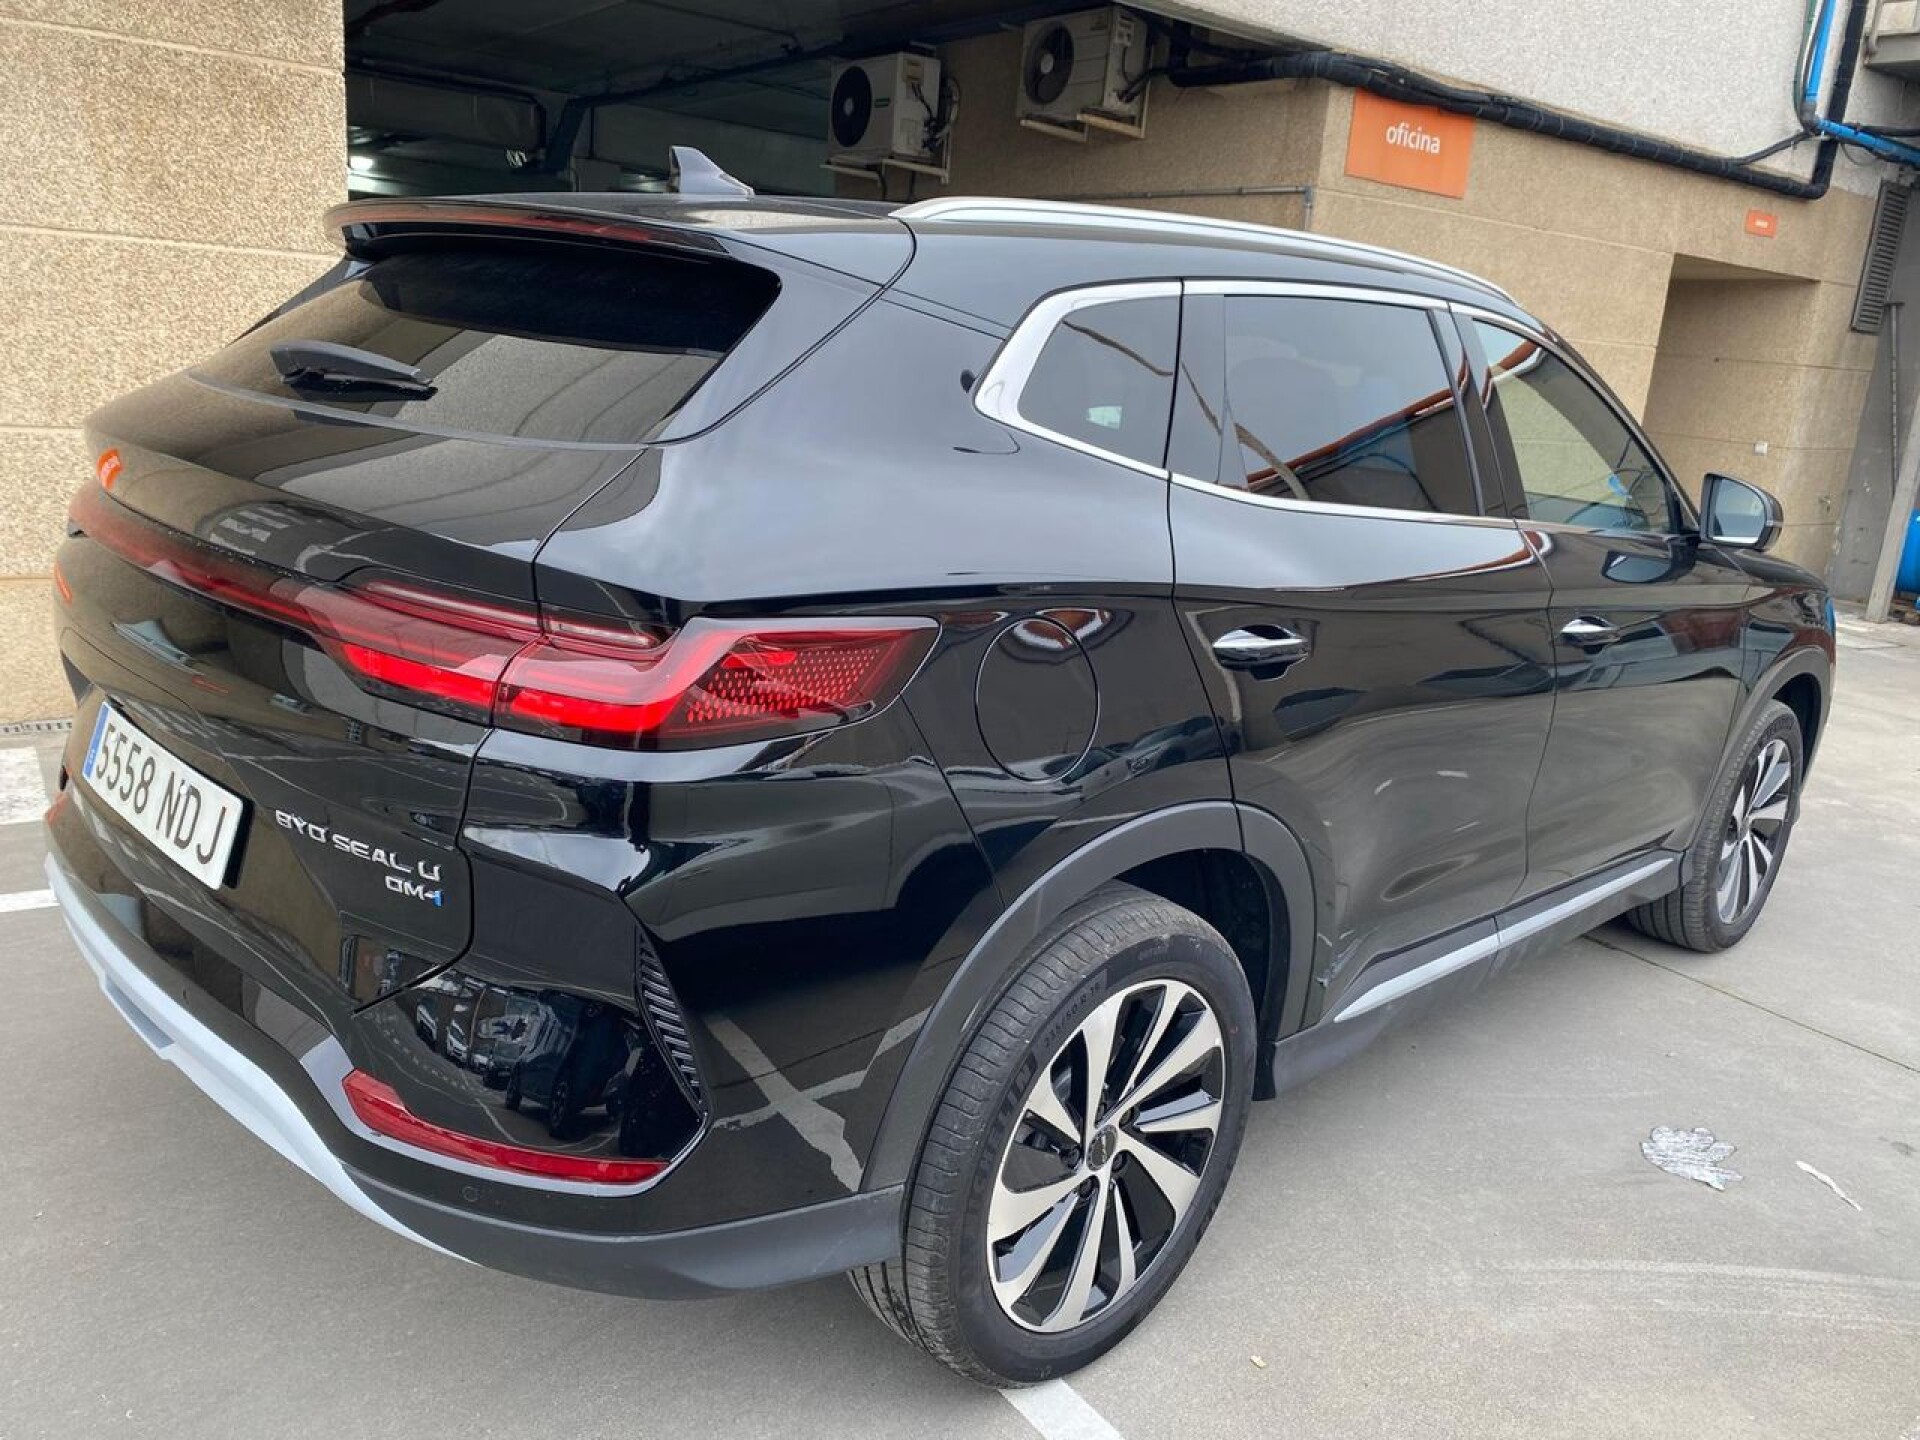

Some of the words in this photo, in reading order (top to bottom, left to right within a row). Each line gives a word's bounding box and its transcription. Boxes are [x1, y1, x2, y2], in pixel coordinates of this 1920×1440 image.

[1385, 122, 1441, 154] oficina
[95, 722, 156, 814] 5558
[155, 771, 227, 865] NDJ
[275, 809, 327, 844] BYD
[332, 833, 414, 874] SEAL
[417, 860, 442, 882] U
